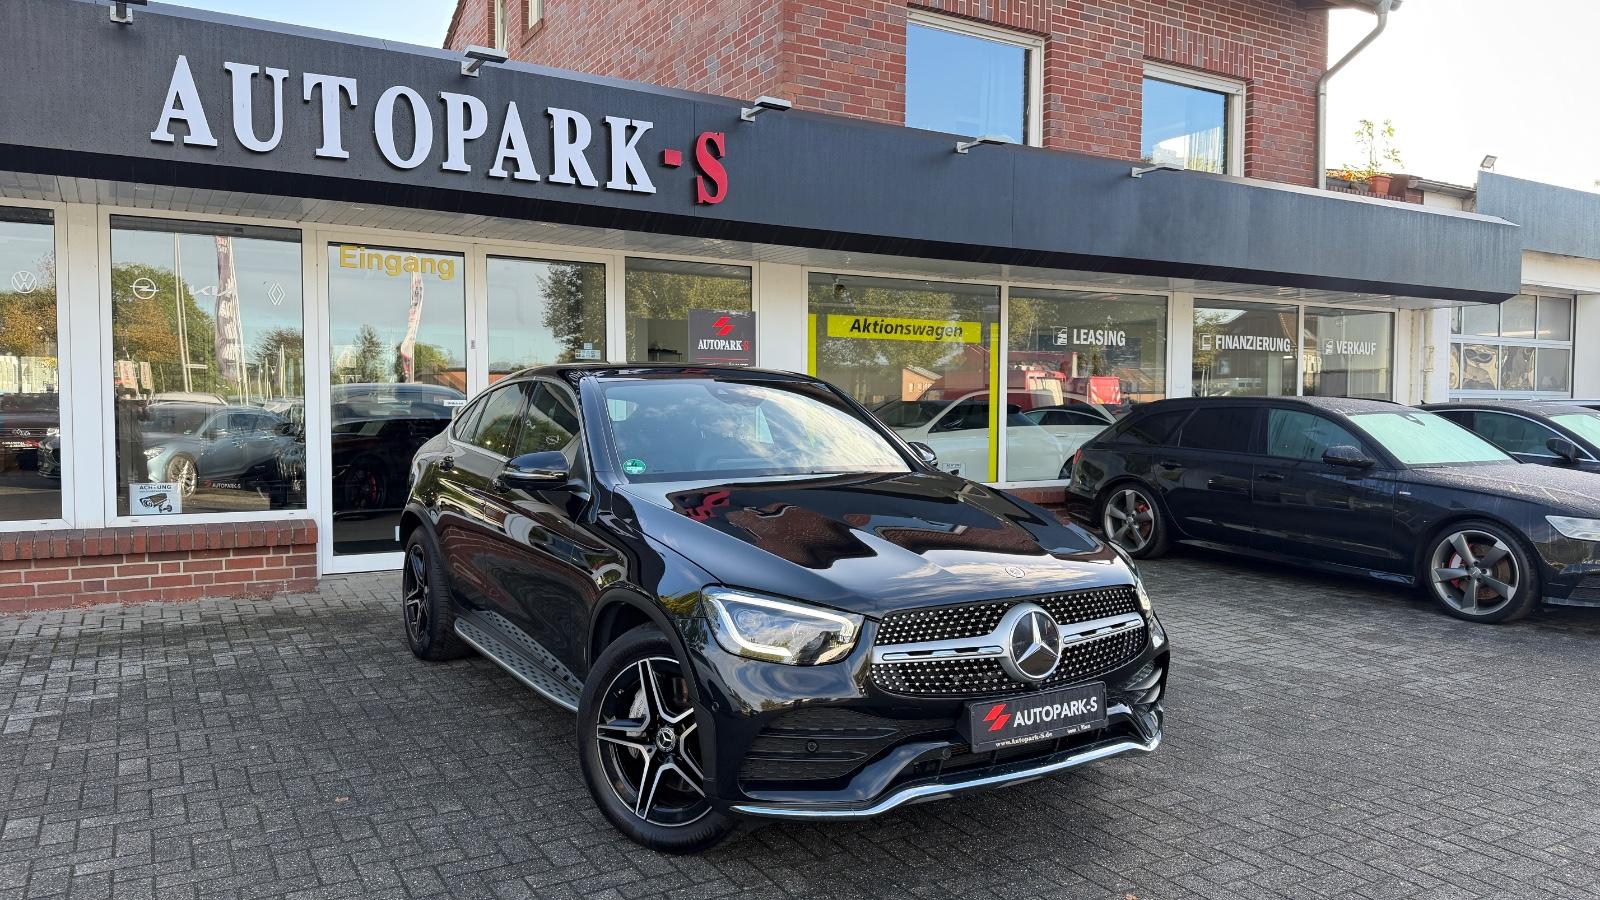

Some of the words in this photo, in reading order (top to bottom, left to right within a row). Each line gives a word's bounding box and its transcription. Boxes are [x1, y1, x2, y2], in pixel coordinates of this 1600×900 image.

[150, 54, 729, 206] AUTOPARK-S
[339, 244, 456, 281] Eingang
[849, 317, 963, 341] Aktionswagen
[1073, 328, 1126, 347] LEASING
[1215, 334, 1291, 352] FINANZIERUNG
[1336, 340, 1377, 356] VERKAUF
[1013, 696, 1098, 728] AUTOPARK-S
